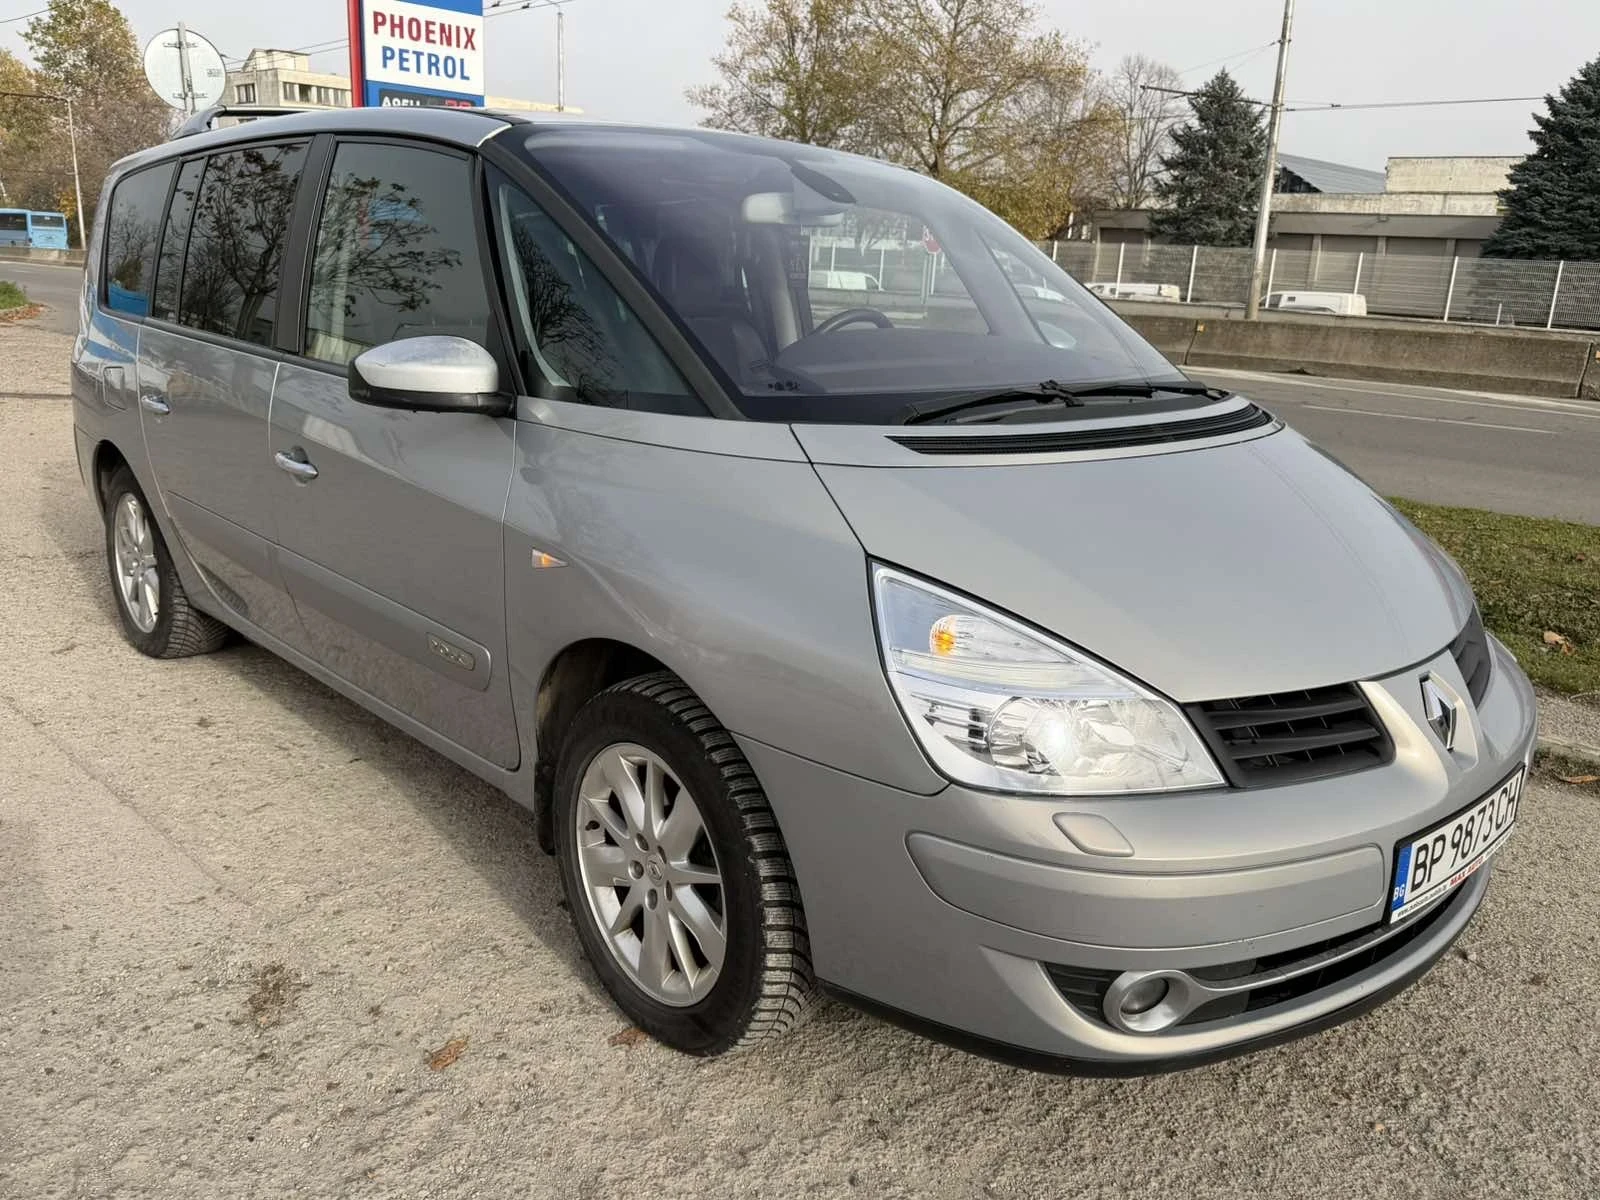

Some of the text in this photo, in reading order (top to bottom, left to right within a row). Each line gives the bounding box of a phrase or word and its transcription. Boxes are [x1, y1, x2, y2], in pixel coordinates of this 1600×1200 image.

[373, 11, 476, 51] PHOENIX
[382, 45, 470, 81] PETROL
[1411, 835, 1447, 893] BP
[1451, 799, 1495, 868] 9873
[1495, 776, 1519, 831] CH
[1394, 884, 1406, 900] BG
